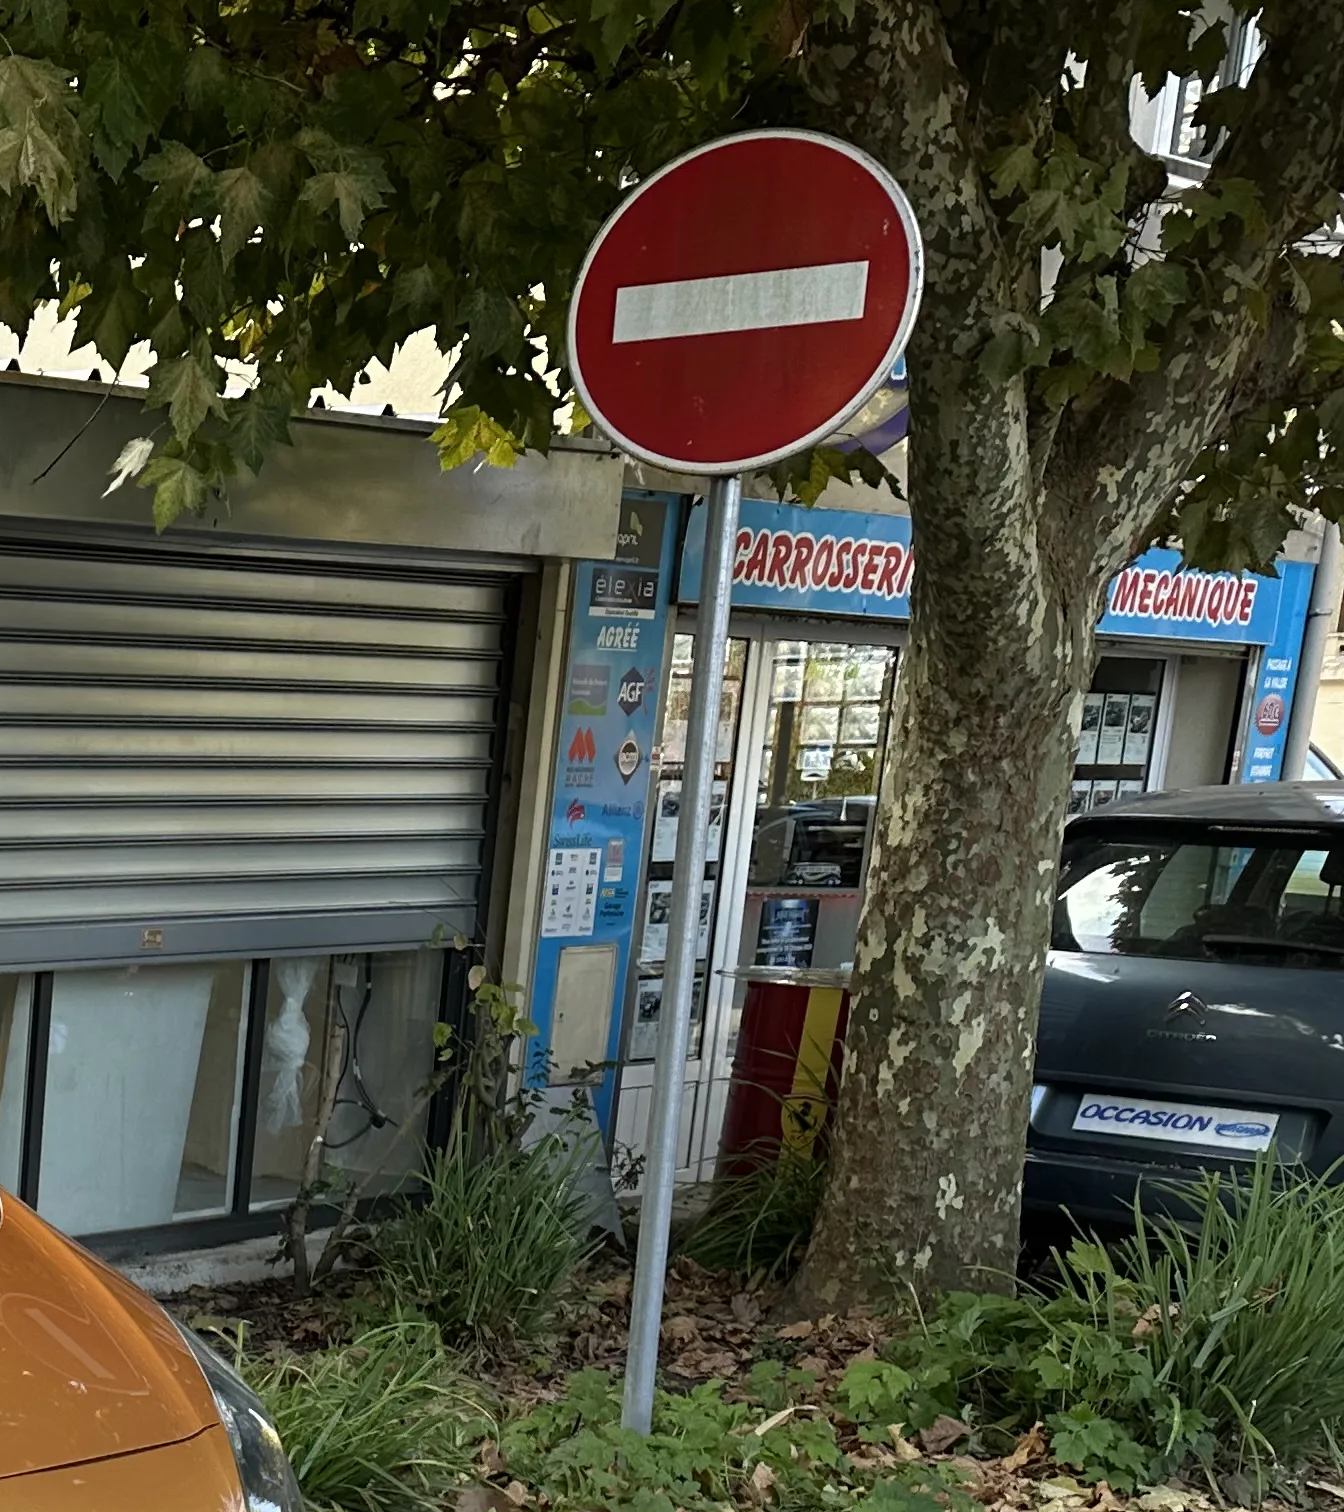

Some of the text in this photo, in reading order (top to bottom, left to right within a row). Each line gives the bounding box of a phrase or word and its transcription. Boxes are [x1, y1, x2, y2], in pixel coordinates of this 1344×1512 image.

[733, 529, 914, 598] CARROSSERI
[1110, 568, 1257, 626] MECANIQUE
[596, 622, 641, 650] AGRÉÉ
[617, 682, 645, 702] AGF
[1079, 1103, 1213, 1132] OCCASION
